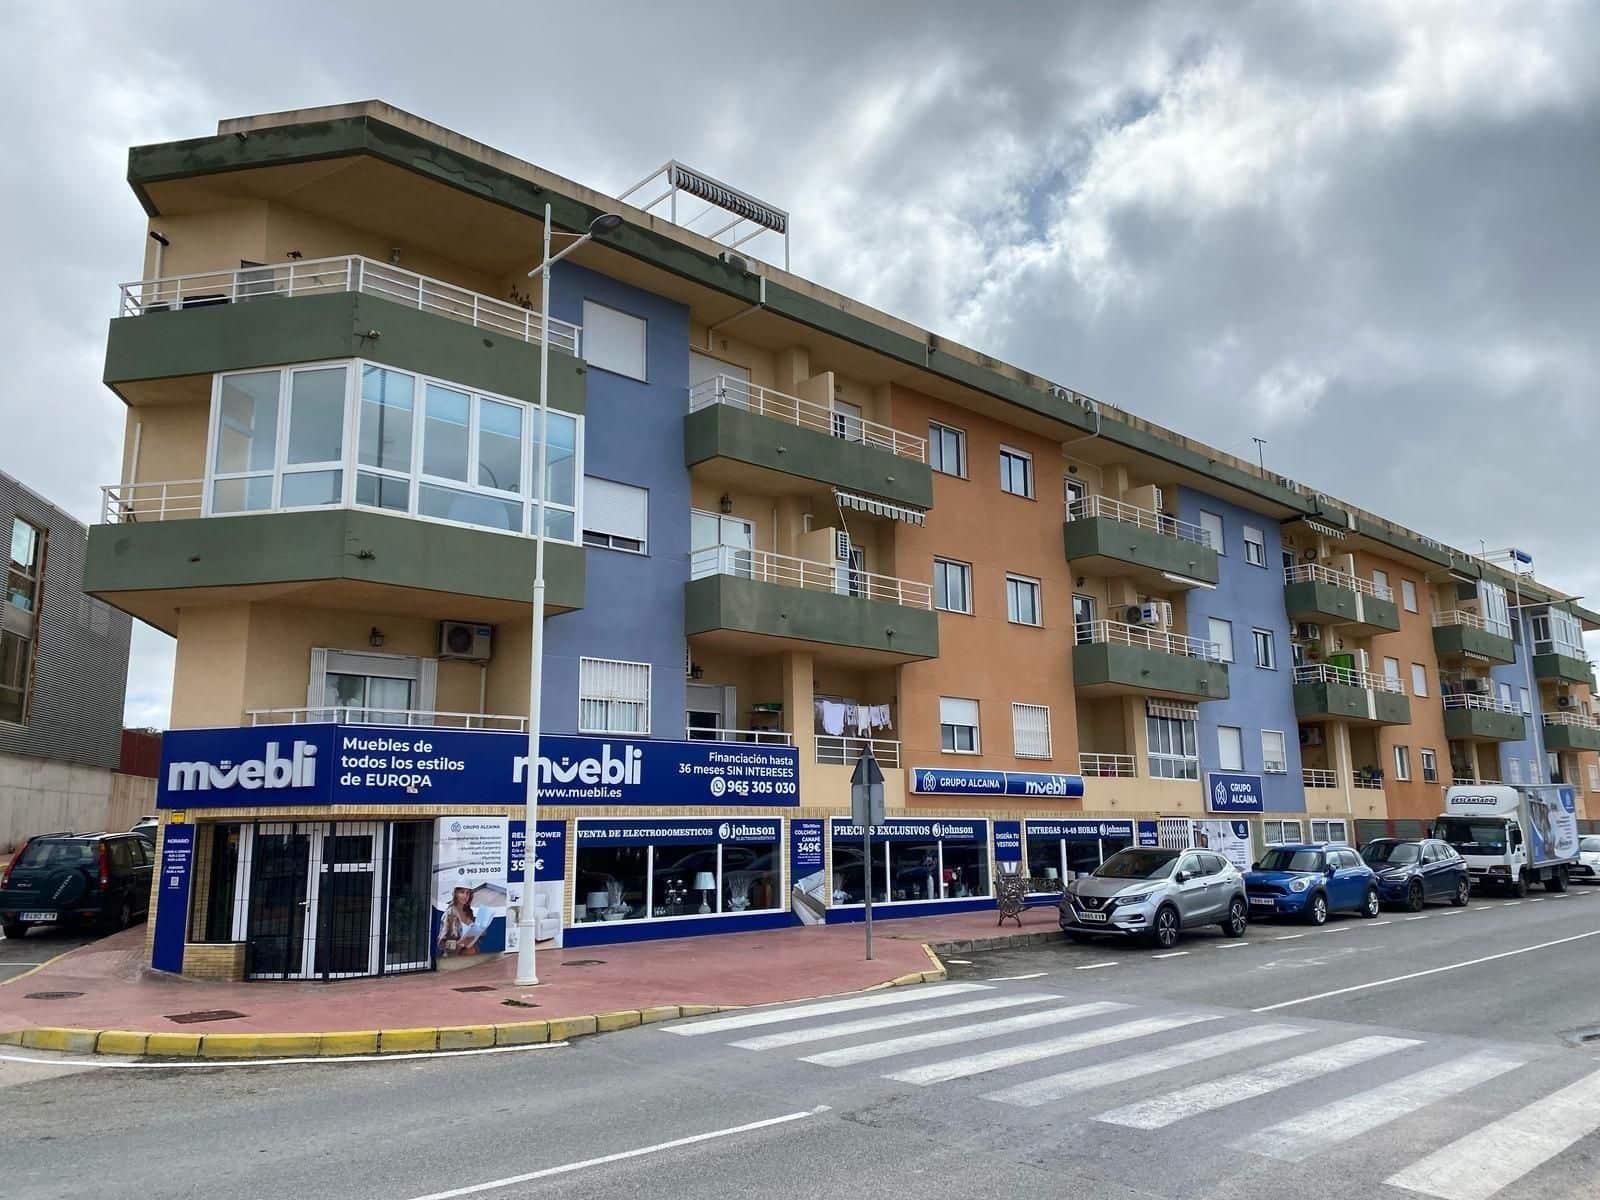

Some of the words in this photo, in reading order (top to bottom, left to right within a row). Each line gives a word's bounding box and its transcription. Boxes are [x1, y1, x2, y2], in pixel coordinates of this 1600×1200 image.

[343, 738, 410, 752] Muebles
[414, 740, 432, 754] de
[341, 756, 387, 770] todos
[391, 756, 414, 770] los
[416, 757, 464, 771] estilos
[512, 744, 642, 785] muebli
[708, 751, 768, 765] Financiación
[770, 753, 794, 766] hasta
[168, 740, 318, 791] muebli
[678, 764, 692, 774] 36
[694, 766, 724, 775] meses
[727, 766, 742, 776] SIN
[745, 766, 794, 778] INTERESES
[340, 772, 360, 786] de
[366, 774, 432, 787] EUROPA
[940, 778, 966, 787] GRUPO
[968, 778, 1000, 788] ALCAINA
[1026, 776, 1066, 795] muebli
[536, 787, 622, 798] www.muebli.es
[728, 780, 749, 793] 965
[752, 781, 772, 794] 305
[775, 782, 796, 794] 030
[1230, 784, 1251, 792] GRUPO
[1232, 794, 1257, 804] ALCAINA
[577, 830, 606, 838] VENTA
[623, 828, 713, 837] ELECTRODOMESTICOS
[731, 825, 775, 840] johnson
[877, 826, 930, 835] EXCLUSIVOS
[940, 824, 974, 837] johnson
[1028, 826, 1061, 834] ENTREGAS
[1106, 825, 1130, 835] johnson
[798, 843, 821, 852] 349€
[511, 859, 544, 871] 39€
